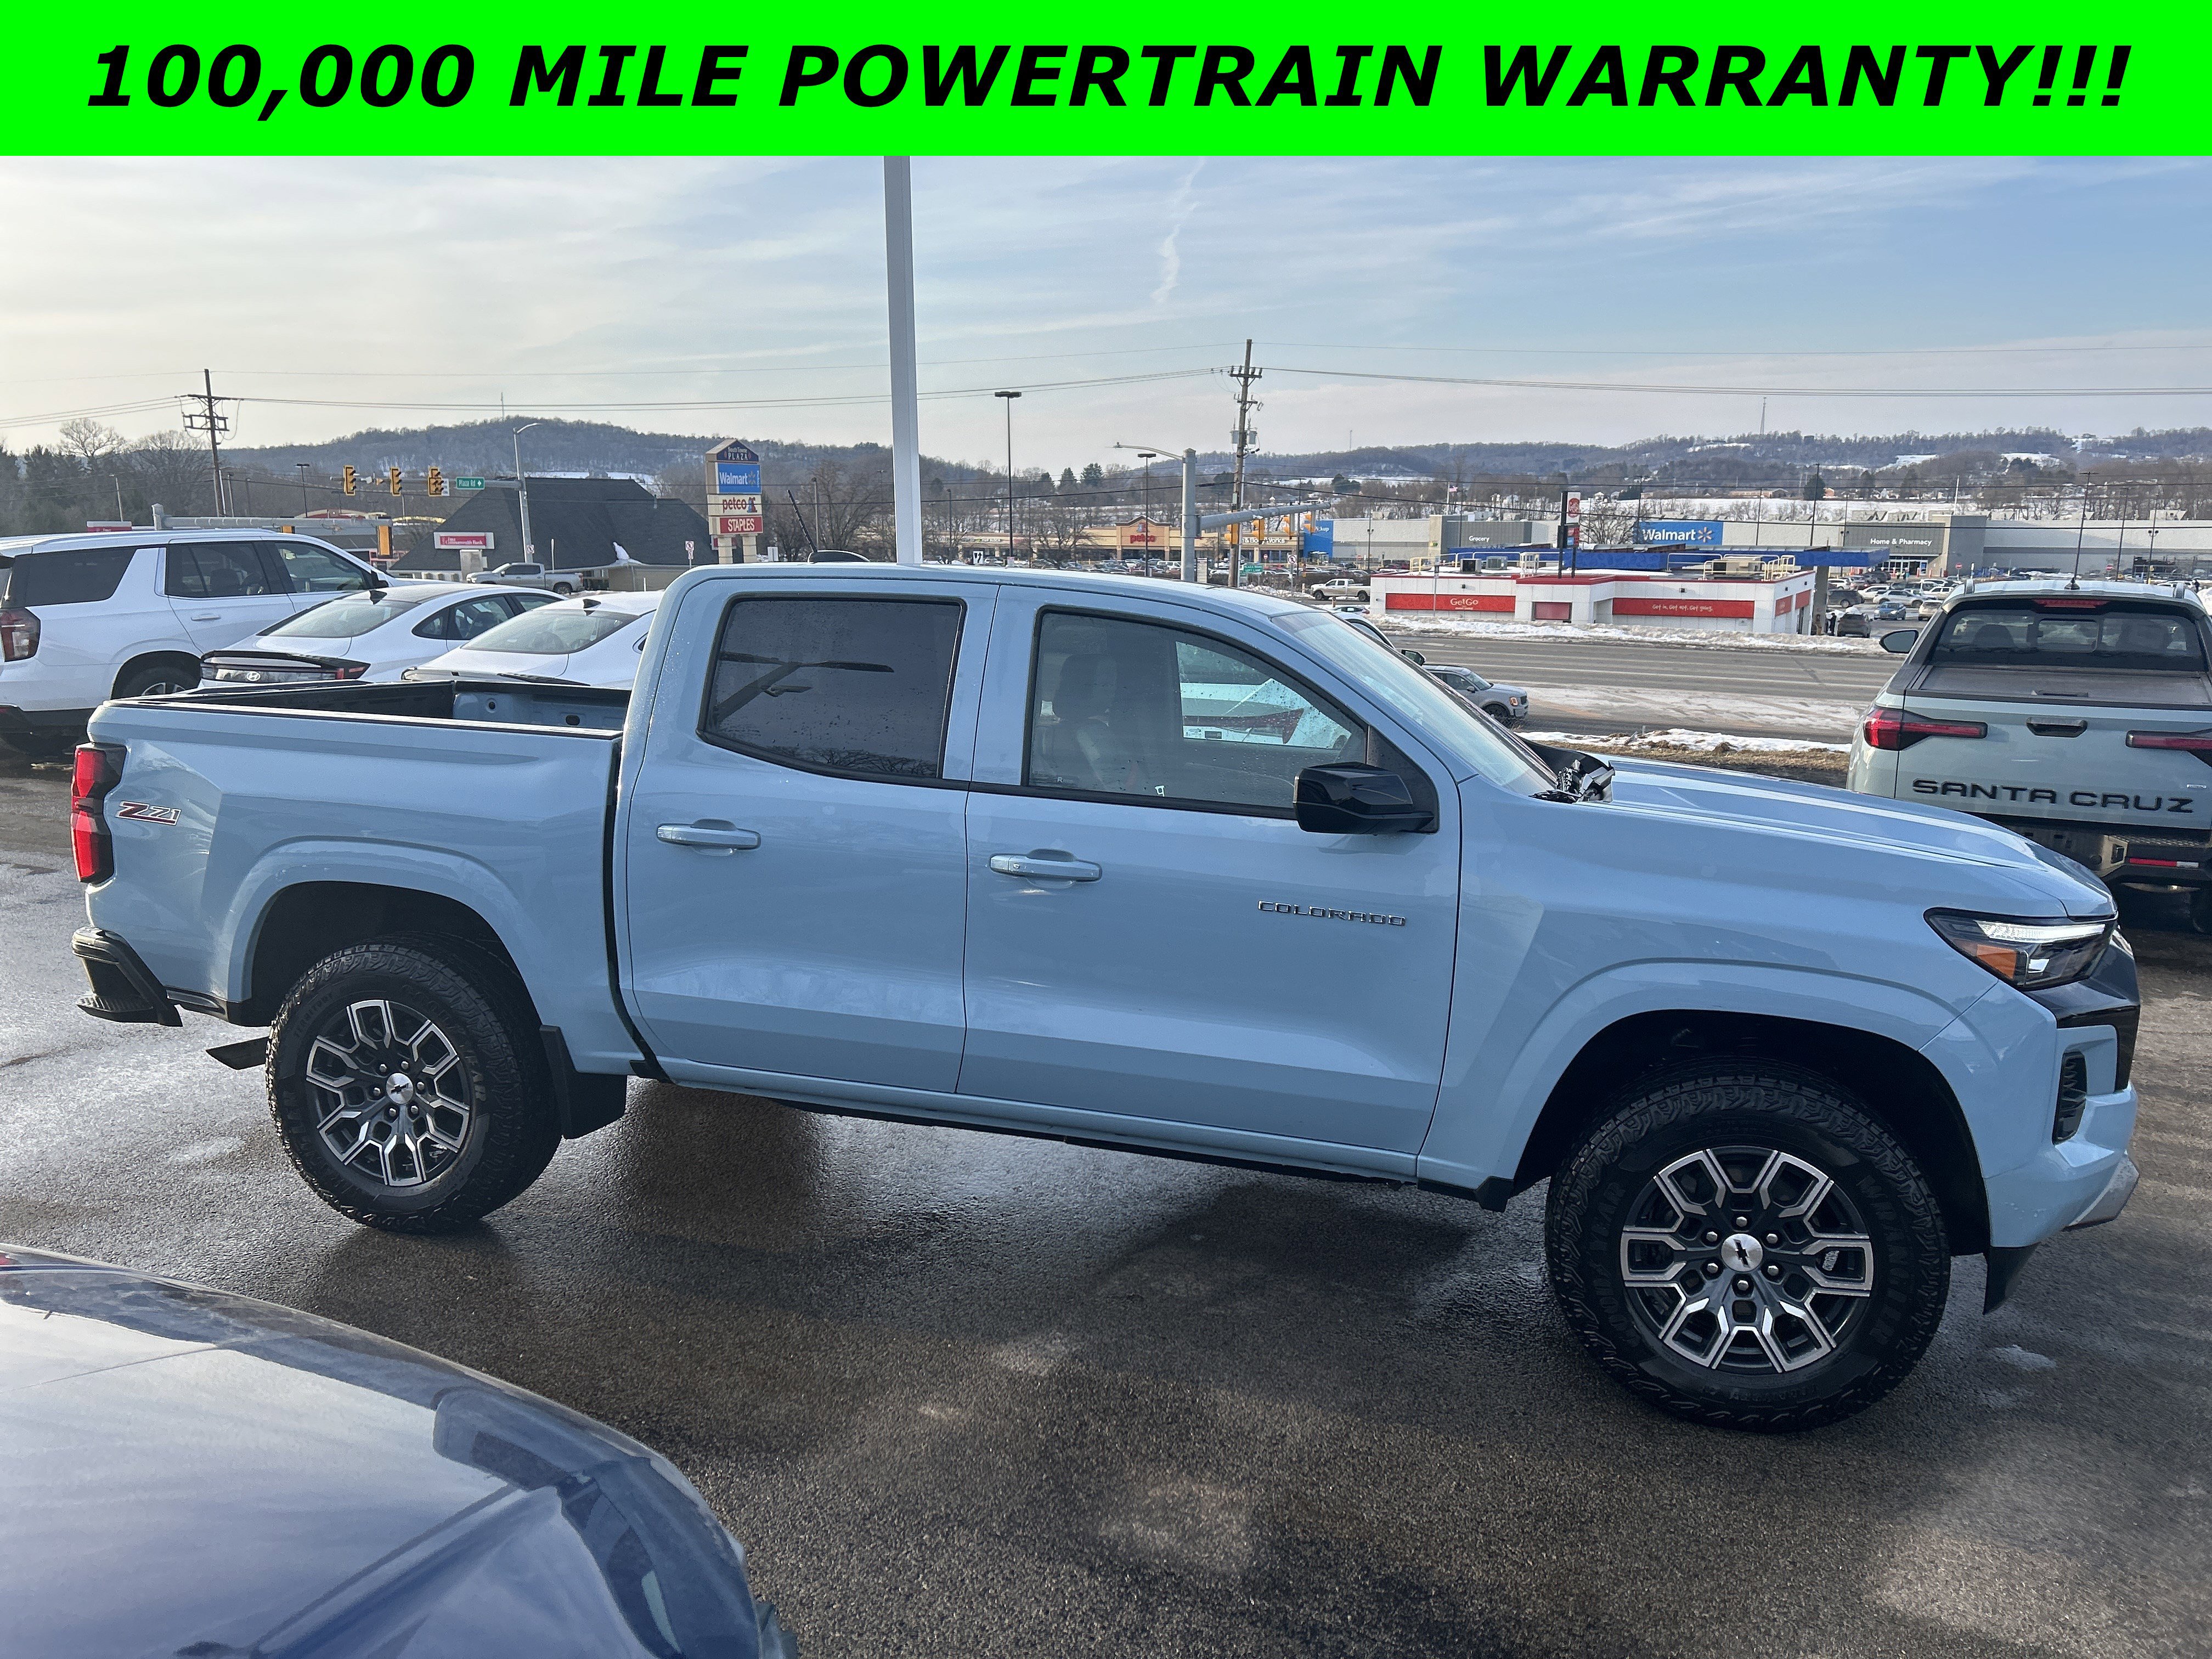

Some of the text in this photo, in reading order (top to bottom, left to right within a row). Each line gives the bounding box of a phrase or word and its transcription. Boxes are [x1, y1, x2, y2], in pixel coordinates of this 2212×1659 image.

[728, 453, 748, 461] PLAZA
[719, 472, 748, 485] Walmart
[722, 496, 747, 514] petco
[727, 518, 755, 532] STAPLES
[1642, 528, 1696, 540] Walmart
[1450, 597, 1479, 606] GetGo
[1912, 777, 2193, 814] SANTA CRUZ
[115, 800, 182, 826] Z71
[1258, 900, 1407, 926] COLORADO
